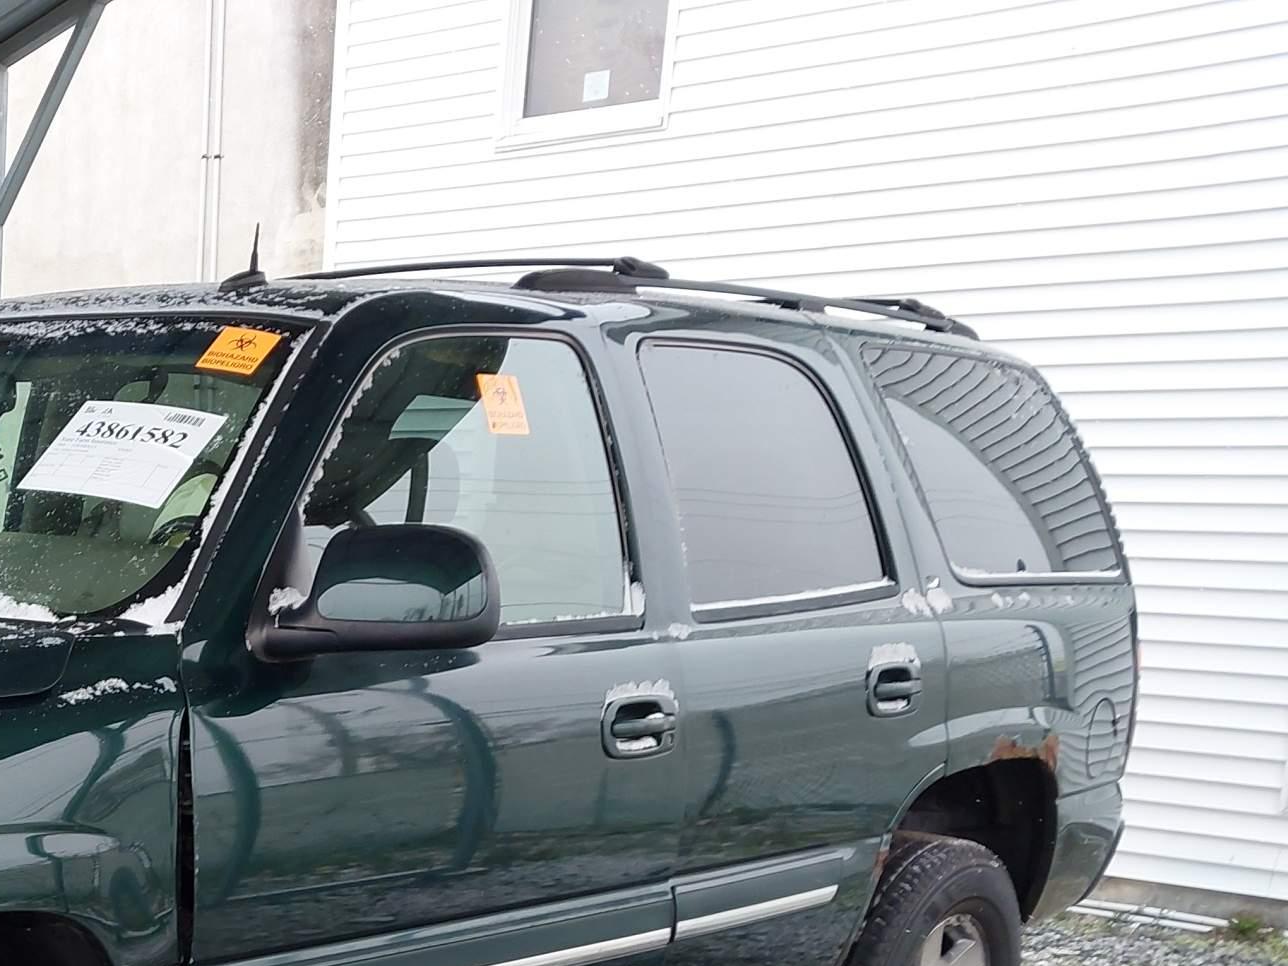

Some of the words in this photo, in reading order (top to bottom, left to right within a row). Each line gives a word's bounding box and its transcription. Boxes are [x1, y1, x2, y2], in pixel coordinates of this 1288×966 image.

[207, 351, 259, 363] BIOHAZARD
[201, 358, 253, 370] BIOPELIGRO
[75, 420, 190, 449] 43861582
